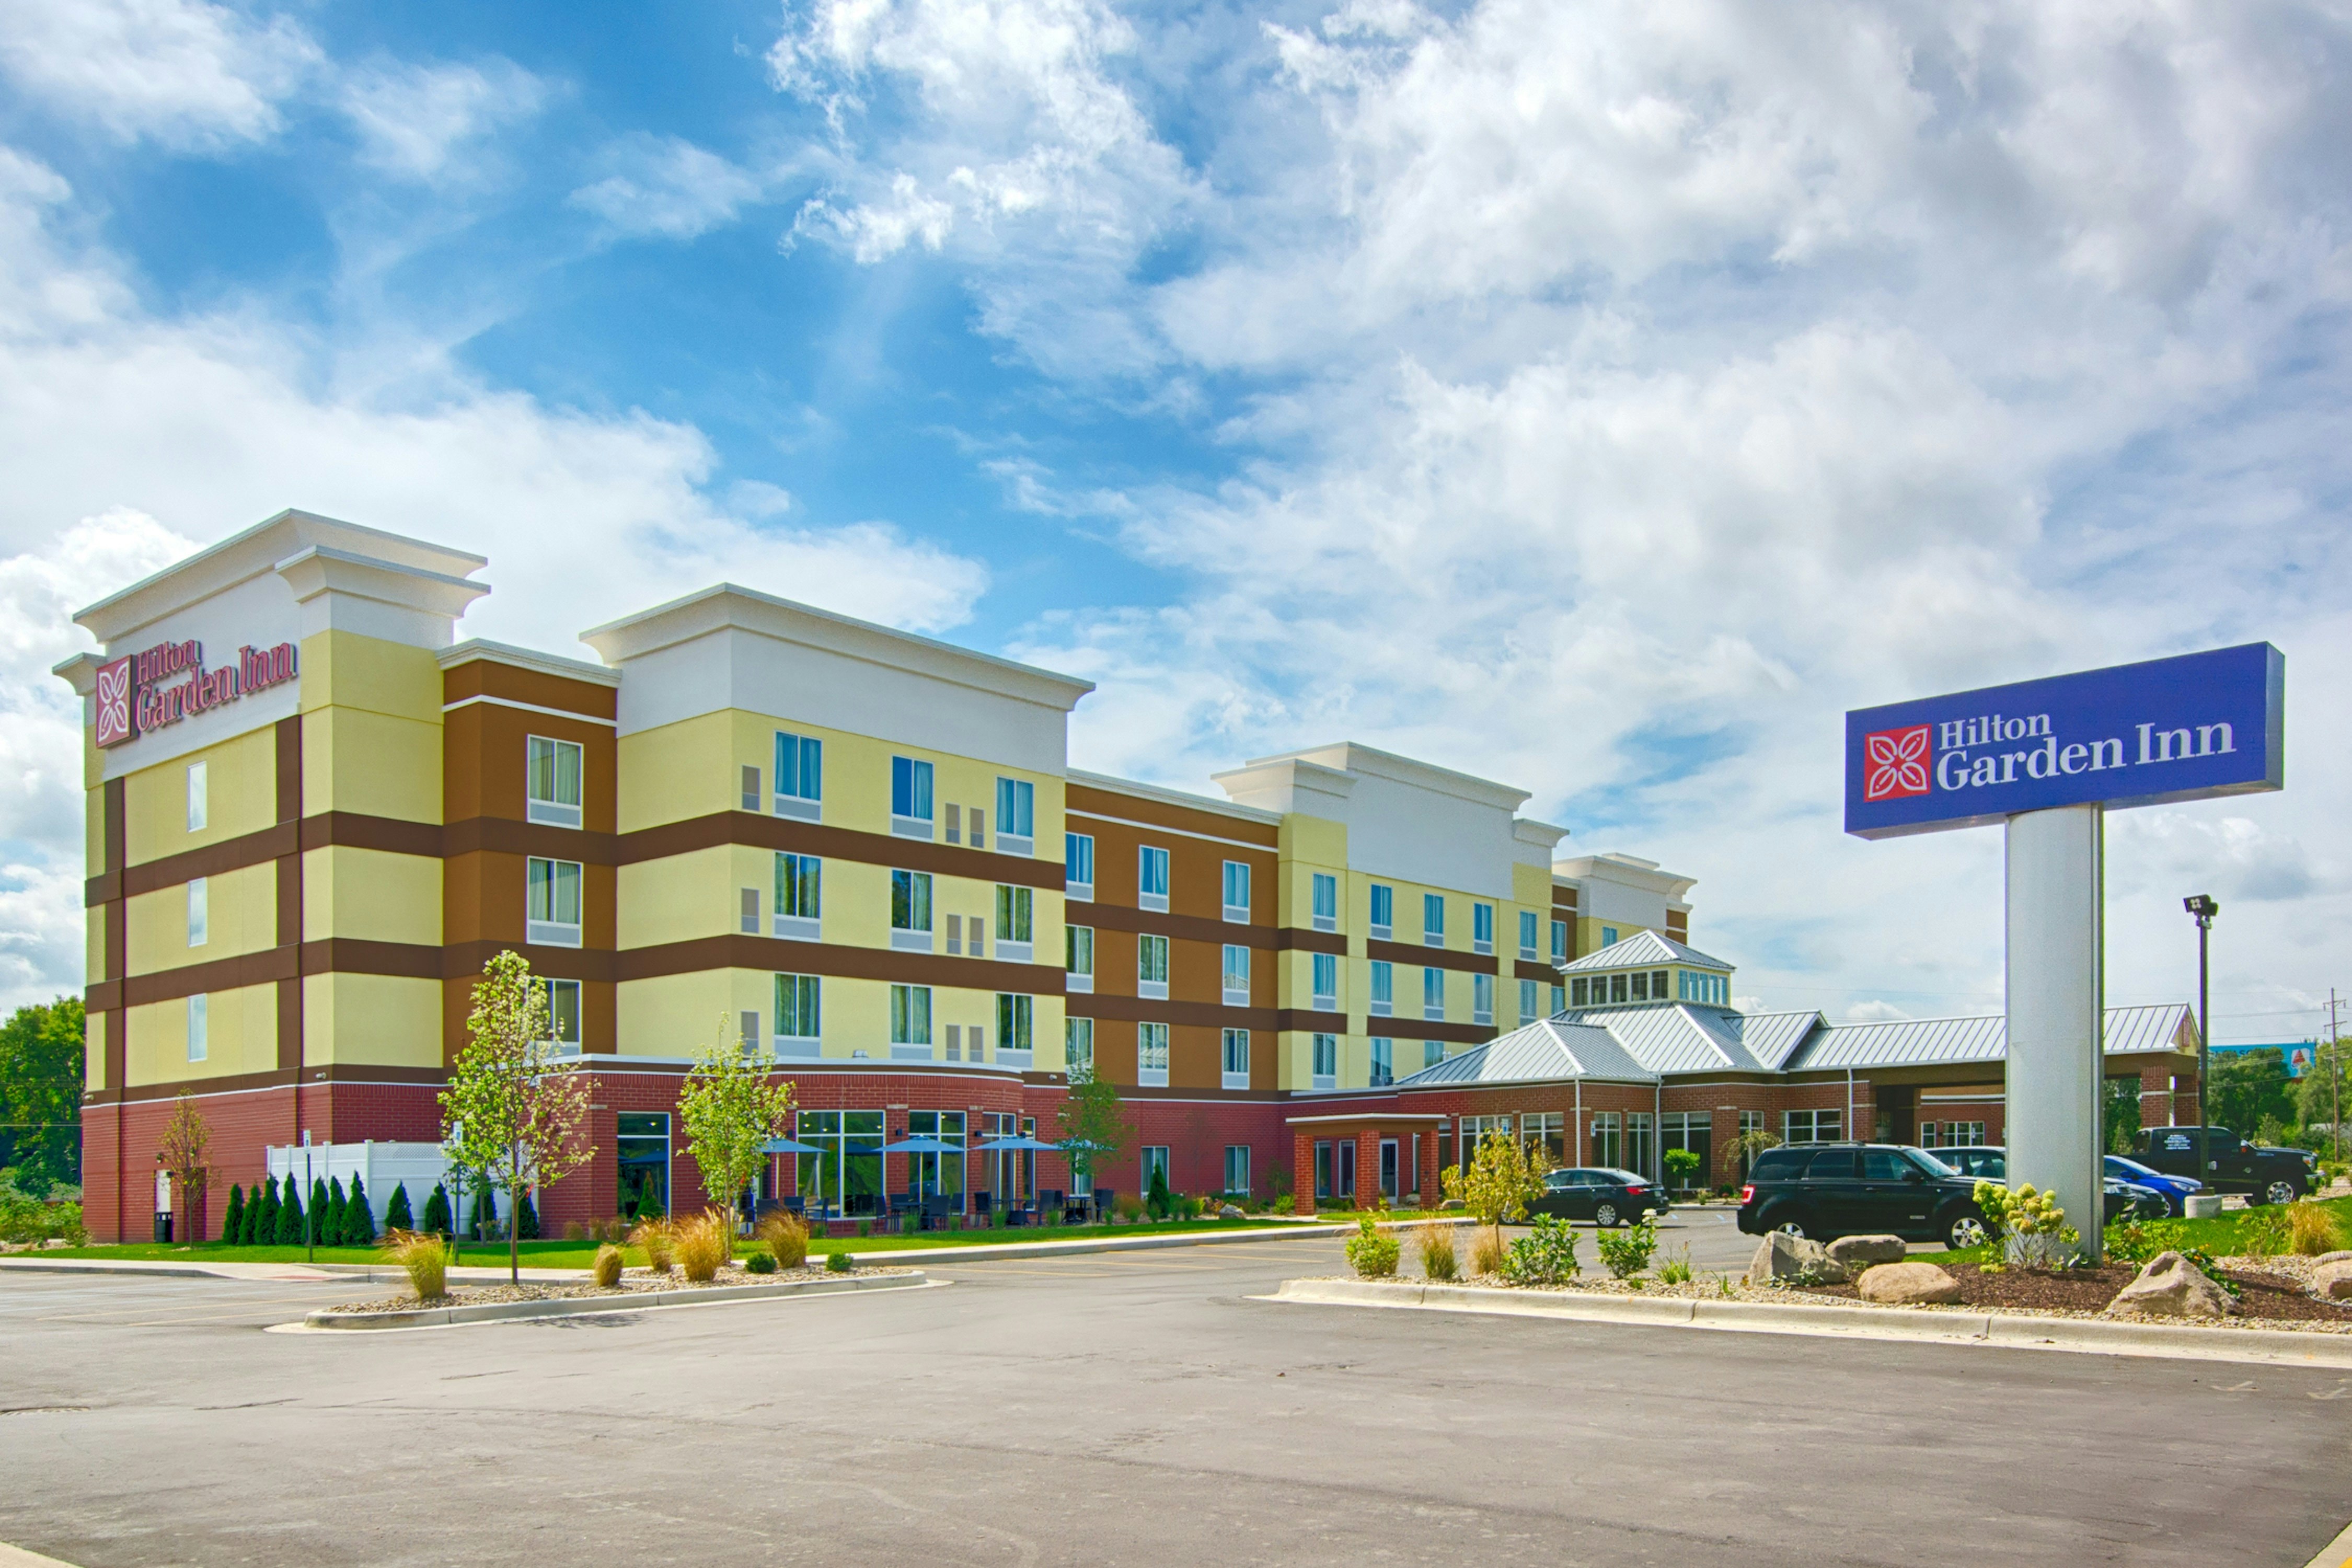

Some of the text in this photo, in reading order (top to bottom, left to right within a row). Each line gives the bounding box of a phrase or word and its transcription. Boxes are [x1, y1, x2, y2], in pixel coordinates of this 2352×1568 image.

[136, 642, 294, 732] Garden Inn
[137, 639, 198, 685] Hilton
[1936, 721, 2237, 791] Garden Inn
[1939, 714, 2052, 751] Hilton
